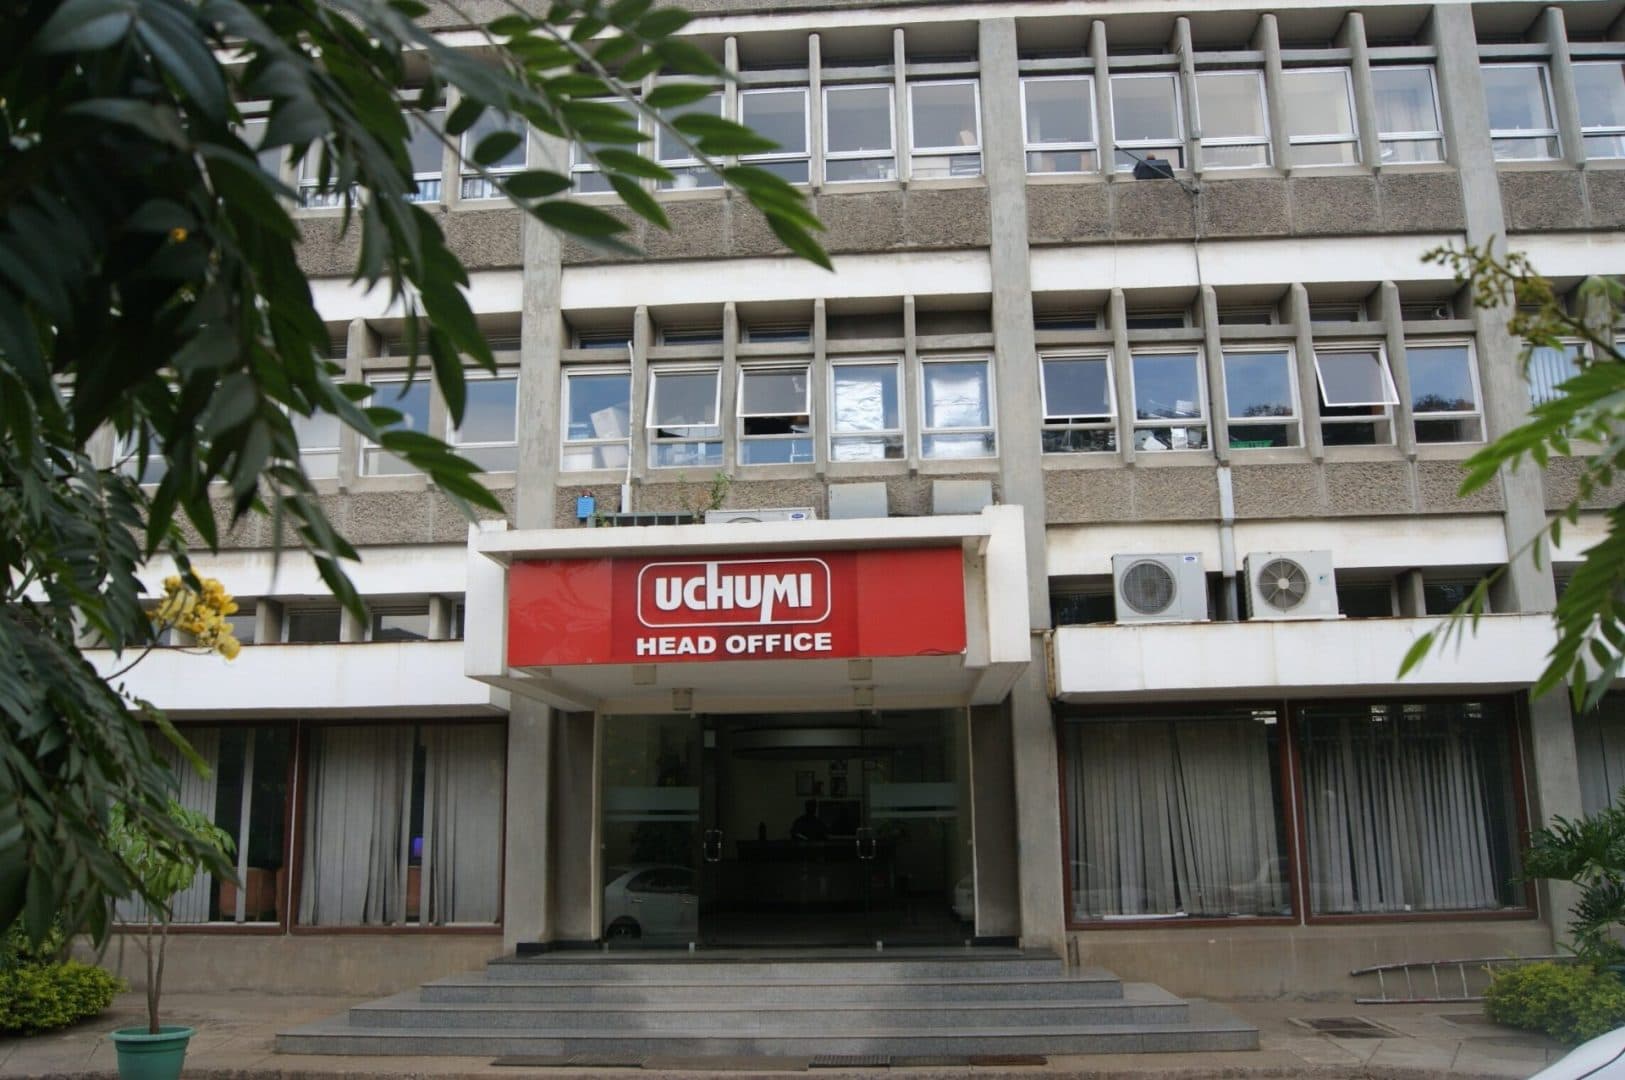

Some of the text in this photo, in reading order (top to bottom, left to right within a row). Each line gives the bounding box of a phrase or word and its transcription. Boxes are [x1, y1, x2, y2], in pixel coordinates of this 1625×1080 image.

[655, 562, 813, 625] UCHUMI
[636, 632, 833, 656] HEAD OFFICE
